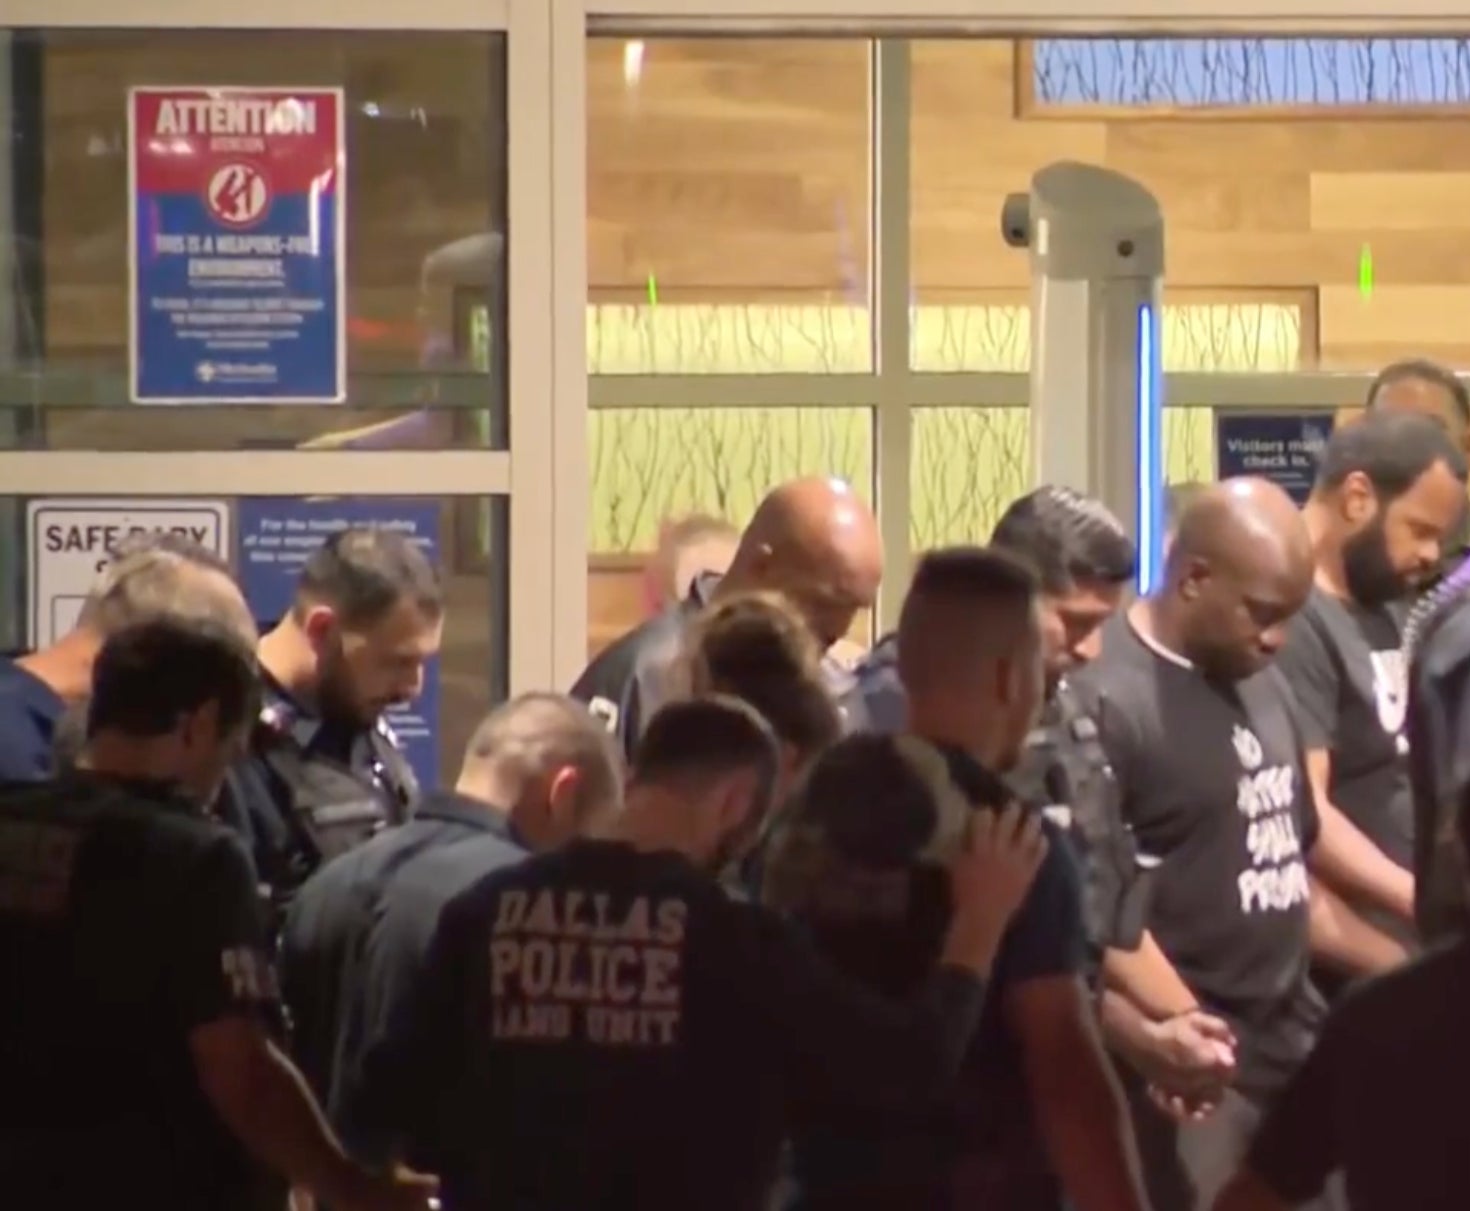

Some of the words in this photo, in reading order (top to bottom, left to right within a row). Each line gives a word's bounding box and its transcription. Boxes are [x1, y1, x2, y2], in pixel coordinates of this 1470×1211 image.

[156, 100, 316, 134] ATTENTION
[203, 236, 214, 253] A
[1227, 438, 1284, 452] Visitors
[1243, 453, 1287, 468] check
[46, 525, 121, 552] SAFE
[260, 518, 282, 532] For
[285, 518, 306, 532] the
[494, 888, 688, 943] DALLAS
[490, 938, 680, 1004] POLICE
[586, 1006, 680, 1043] UNIT
